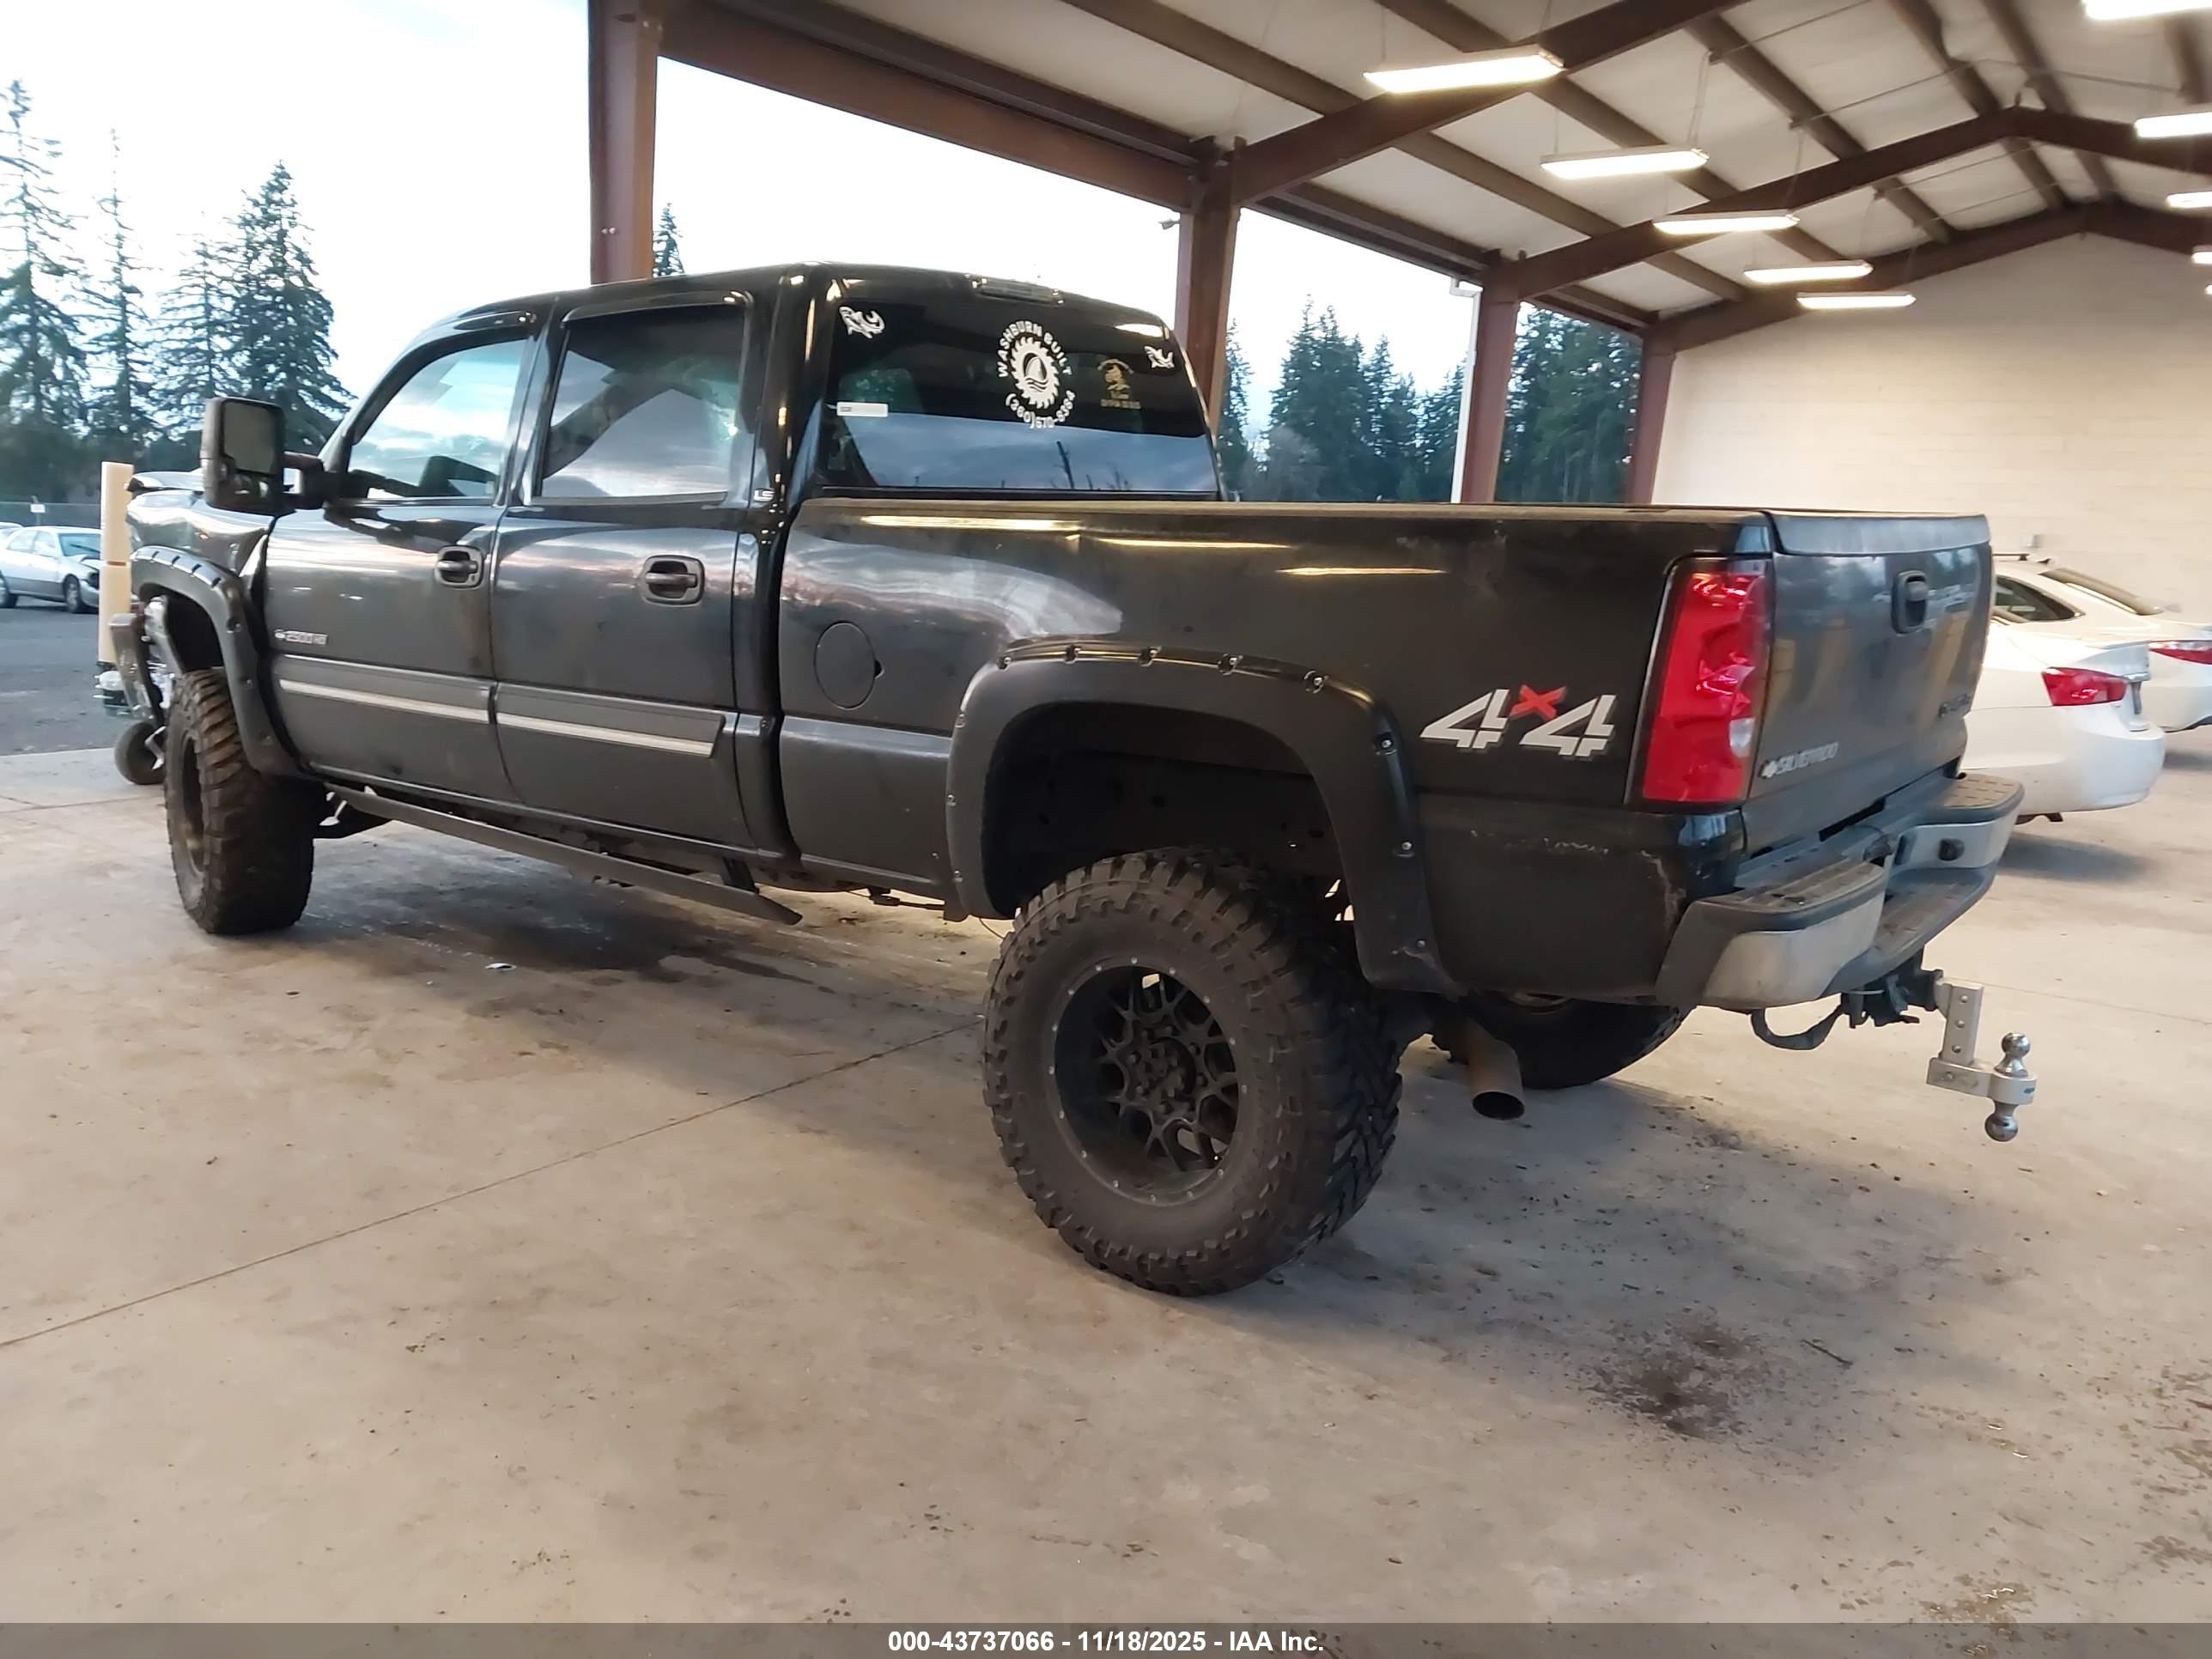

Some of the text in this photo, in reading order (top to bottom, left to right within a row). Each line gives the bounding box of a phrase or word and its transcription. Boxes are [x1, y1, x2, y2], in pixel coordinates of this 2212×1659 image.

[996, 320, 1073, 378] WASHBURN BUILT
[753, 489, 775, 501] LS
[1775, 741, 1839, 775] SILVERADO
